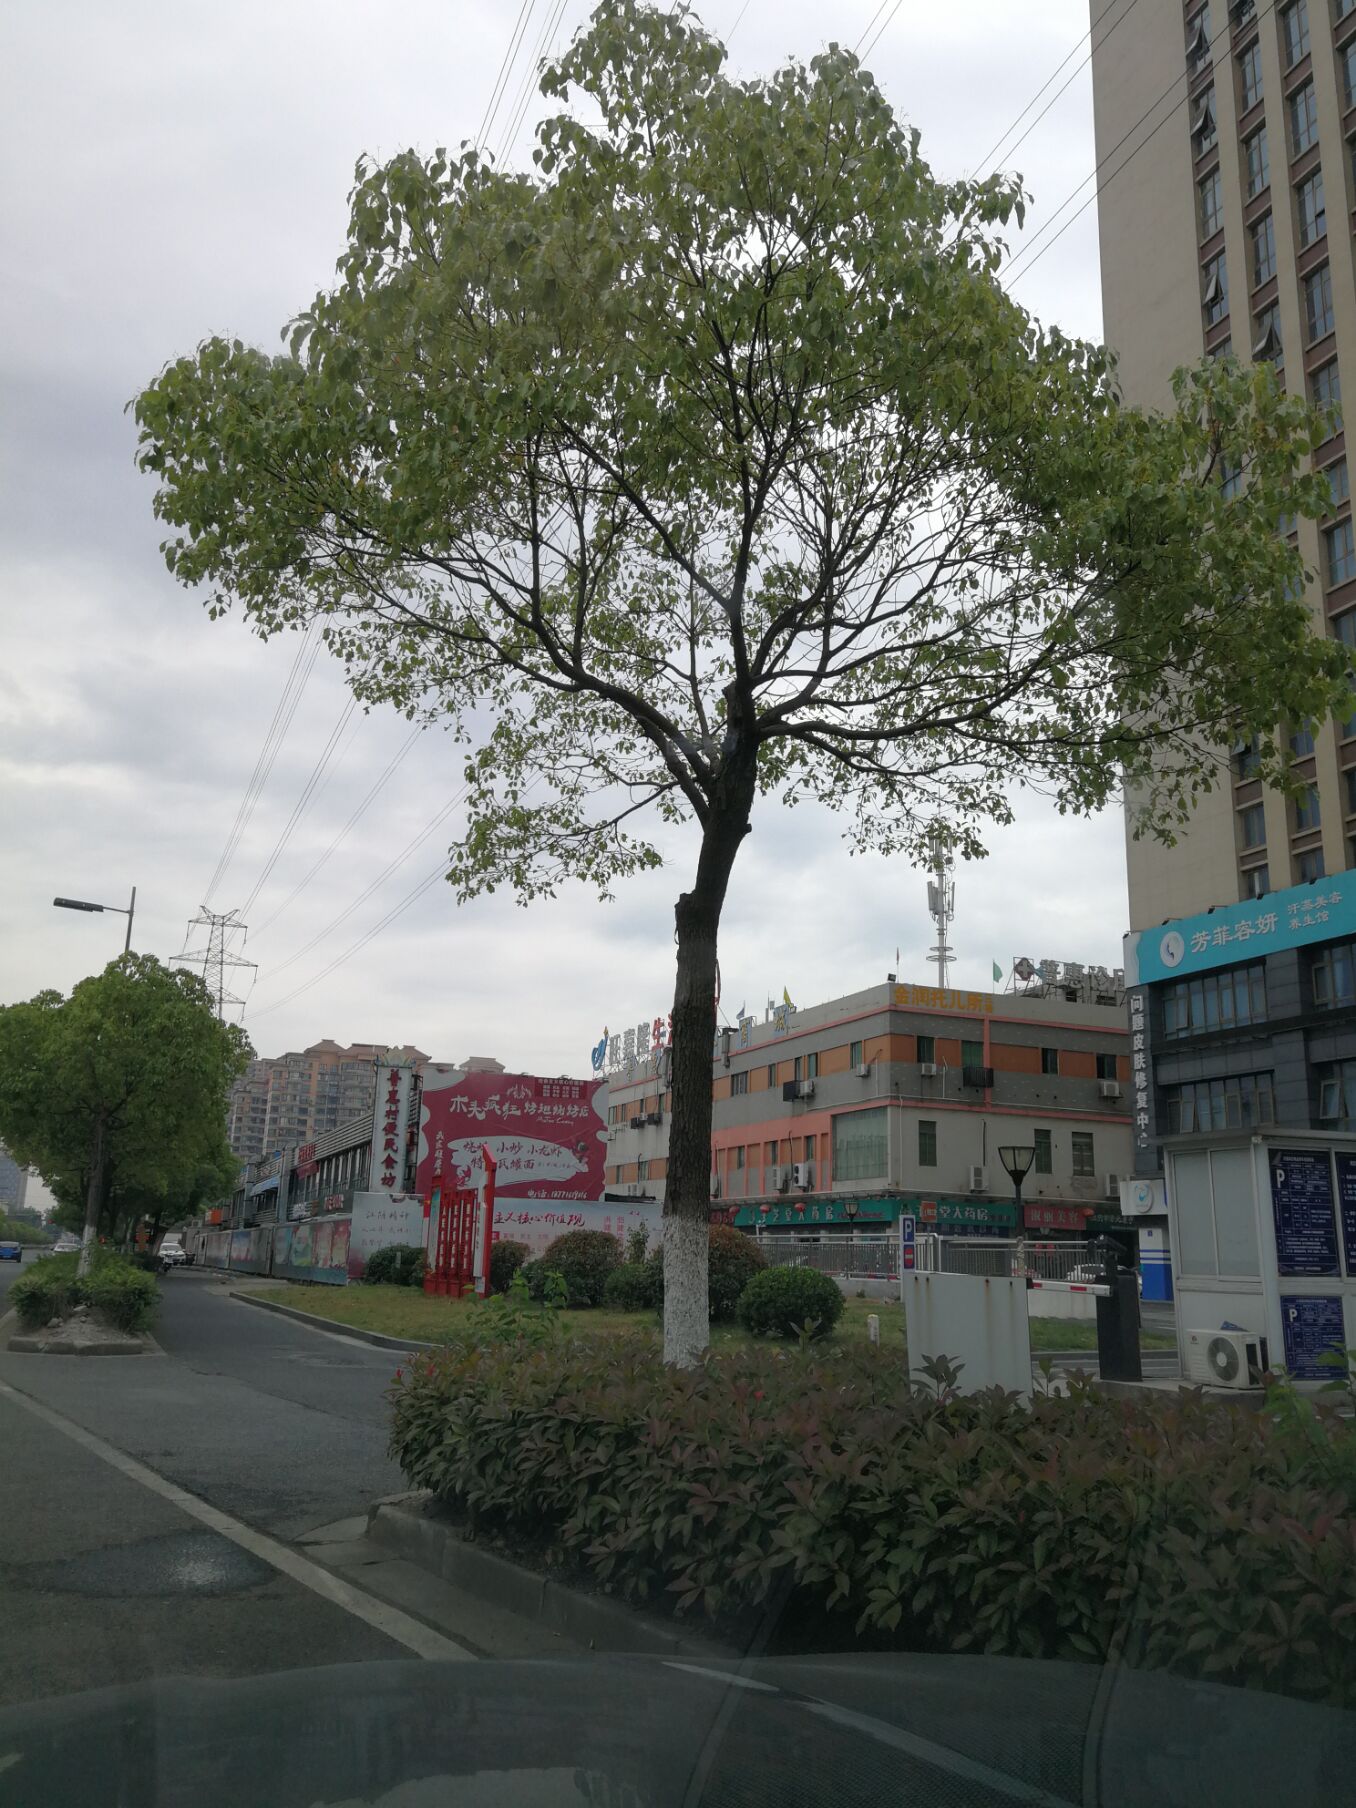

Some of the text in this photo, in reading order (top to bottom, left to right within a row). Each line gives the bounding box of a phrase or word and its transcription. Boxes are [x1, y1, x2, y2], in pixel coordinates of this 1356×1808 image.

[1190, 912, 1279, 953] 芳菲容妍
[1130, 995, 1150, 1148] 问题皮肤修复中心
[1276, 1169, 1285, 1188] P
[904, 1219, 912, 1240] P
[1289, 1308, 1298, 1322] P
